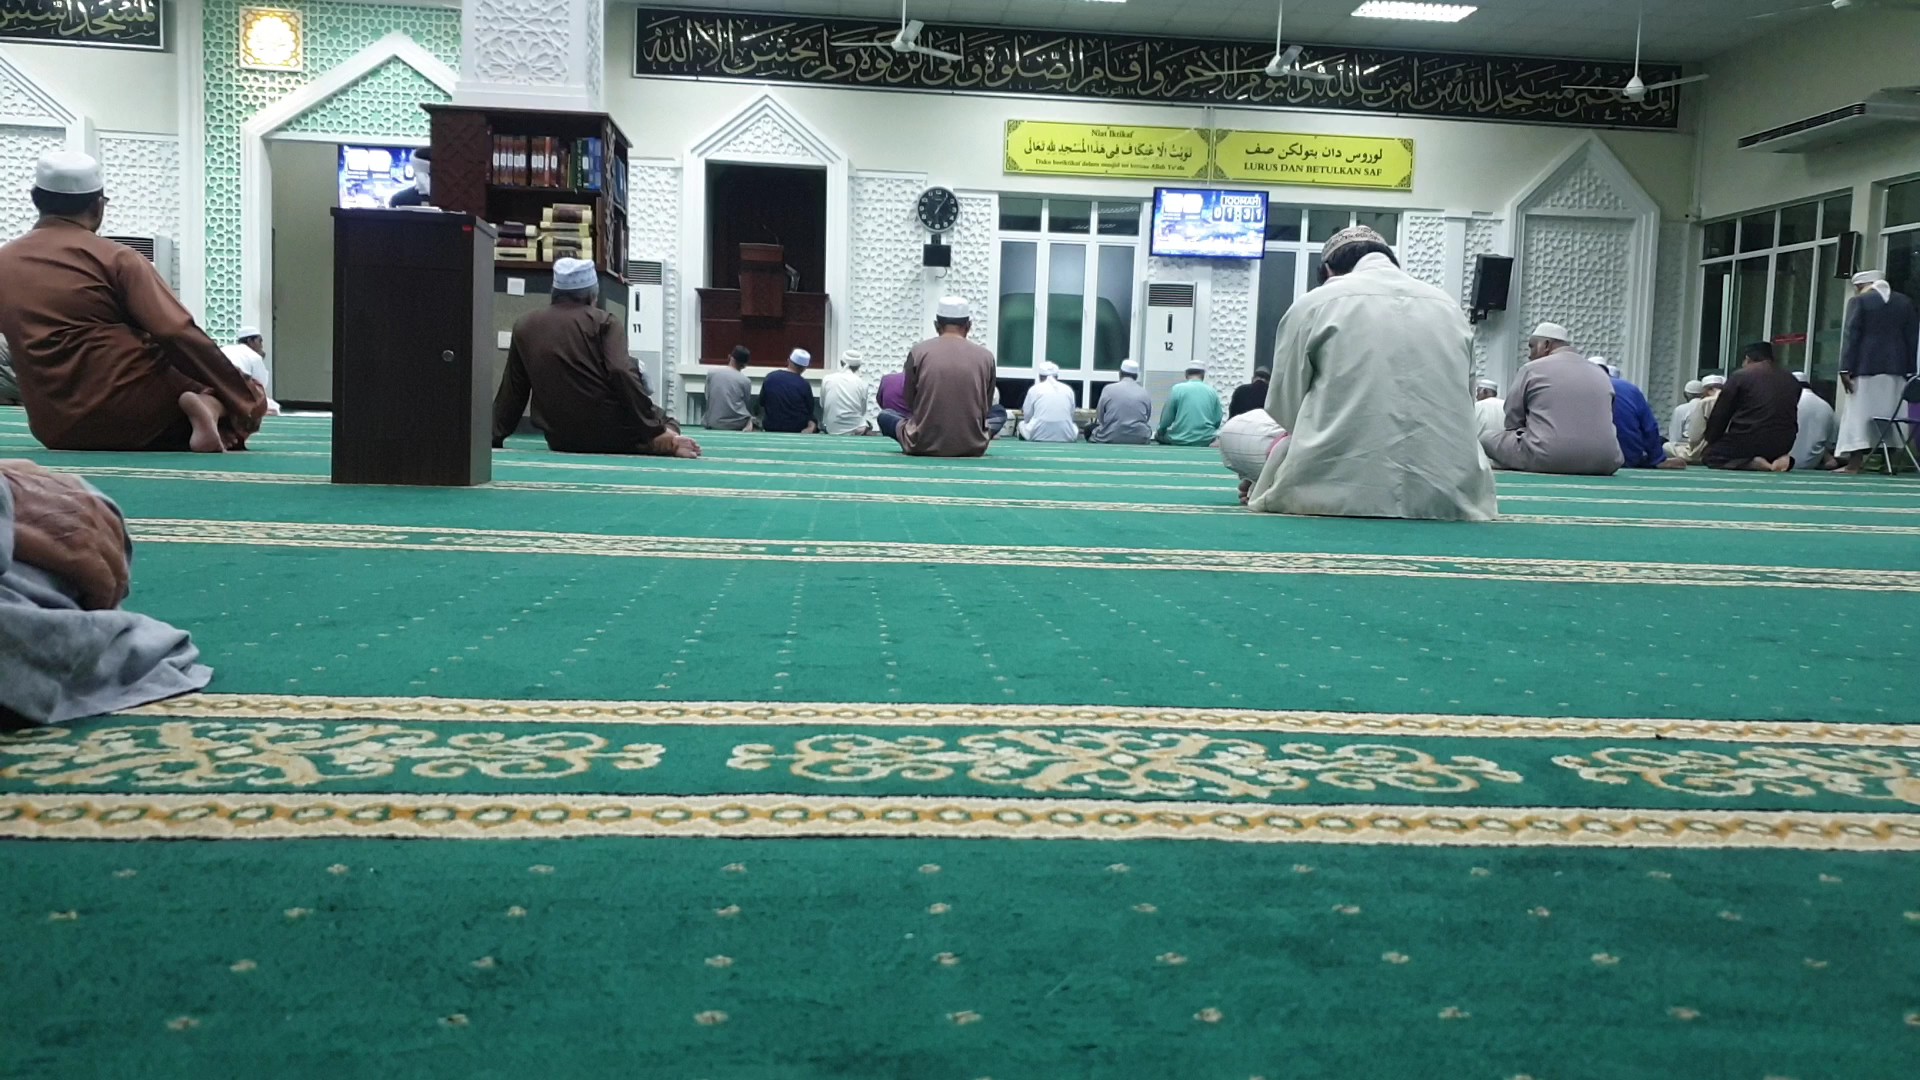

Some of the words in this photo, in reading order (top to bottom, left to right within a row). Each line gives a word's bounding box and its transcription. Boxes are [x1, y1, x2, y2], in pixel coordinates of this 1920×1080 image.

[1091, 129, 1107, 138] Niat
[1109, 130, 1135, 139] Iktikaf
[1245, 142, 1275, 155] صف
[1277, 142, 1318, 161] بتولكن
[1321, 147, 1342, 158] دان
[1345, 148, 1383, 164] لوروس
[1244, 162, 1278, 172] LURUS
[1280, 164, 1304, 173] DAN
[1306, 165, 1362, 175] BETULKAN
[1363, 168, 1383, 176] SAF
[1164, 341, 1174, 351] 12
